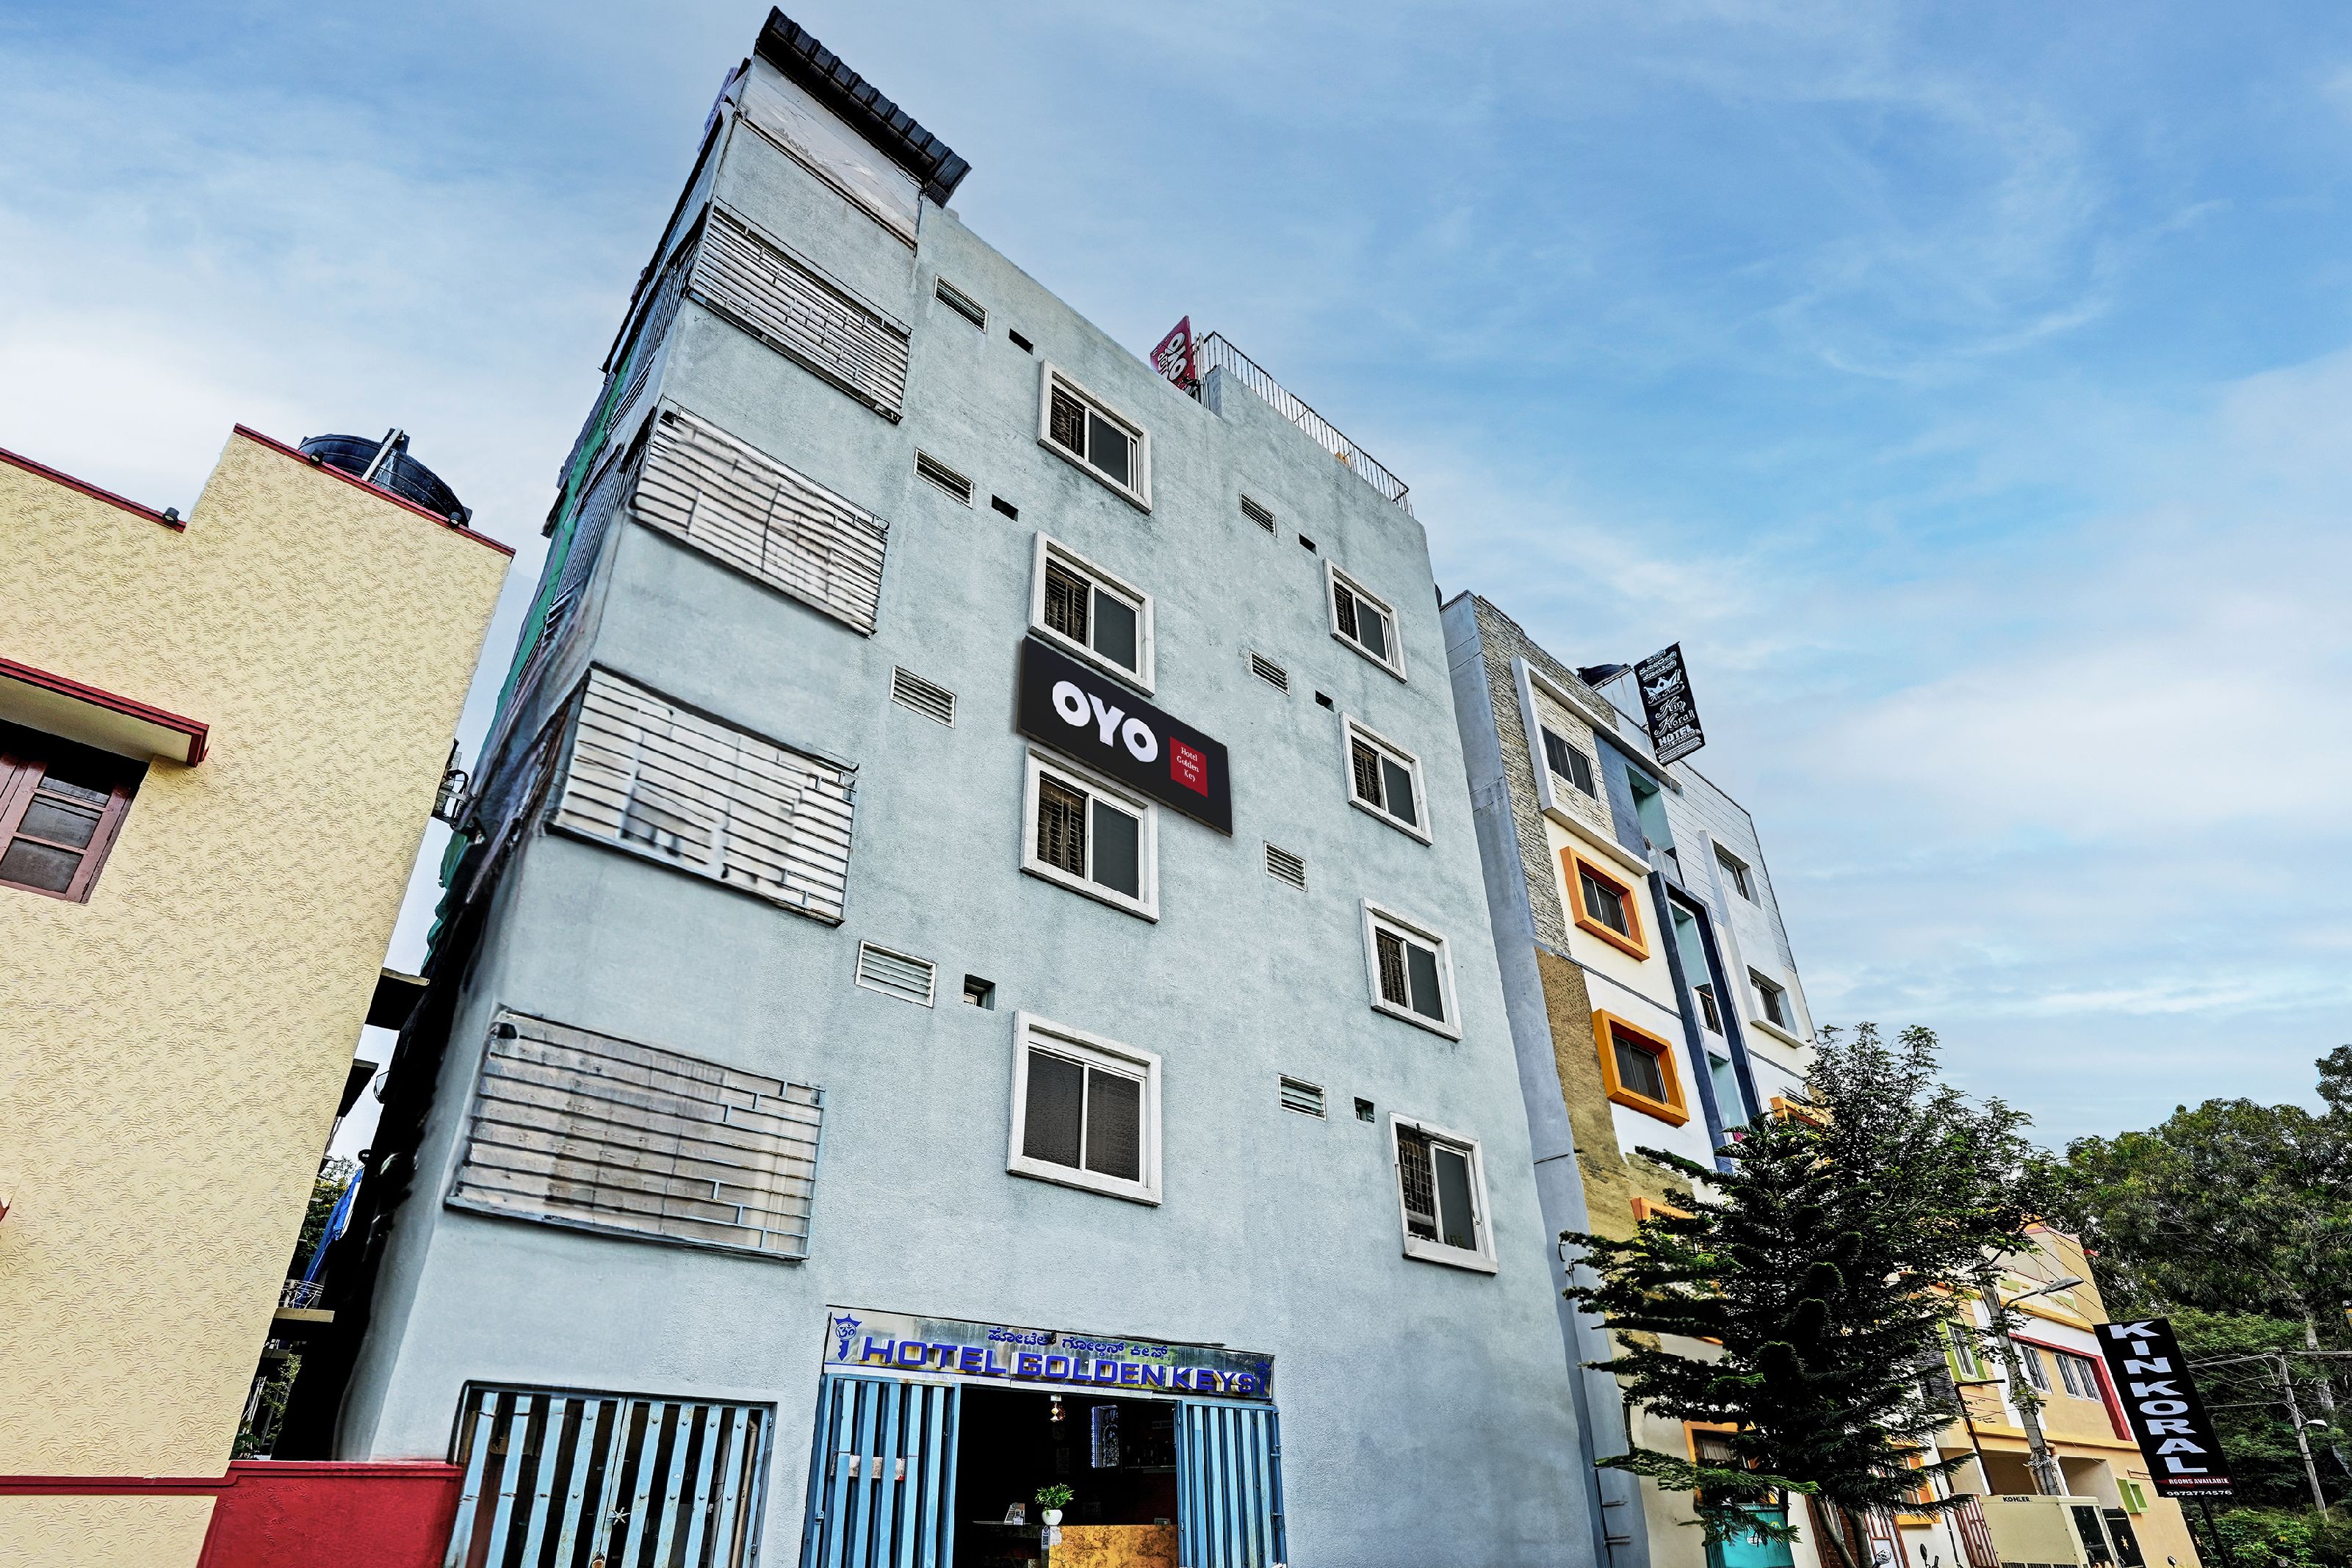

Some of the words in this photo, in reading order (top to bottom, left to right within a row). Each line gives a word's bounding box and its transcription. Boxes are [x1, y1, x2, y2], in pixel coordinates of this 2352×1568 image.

[1052, 680, 1158, 762] OYO
[1658, 723, 1695, 747] HOTEL
[1177, 755, 1200, 773] Golden
[1180, 746, 1198, 762] Hotel
[1183, 768, 1196, 782] Key
[859, 1336, 1007, 1374] HOTEL
[1014, 1352, 1164, 1387] GOLDEN
[1172, 1367, 1256, 1393] KEYS
